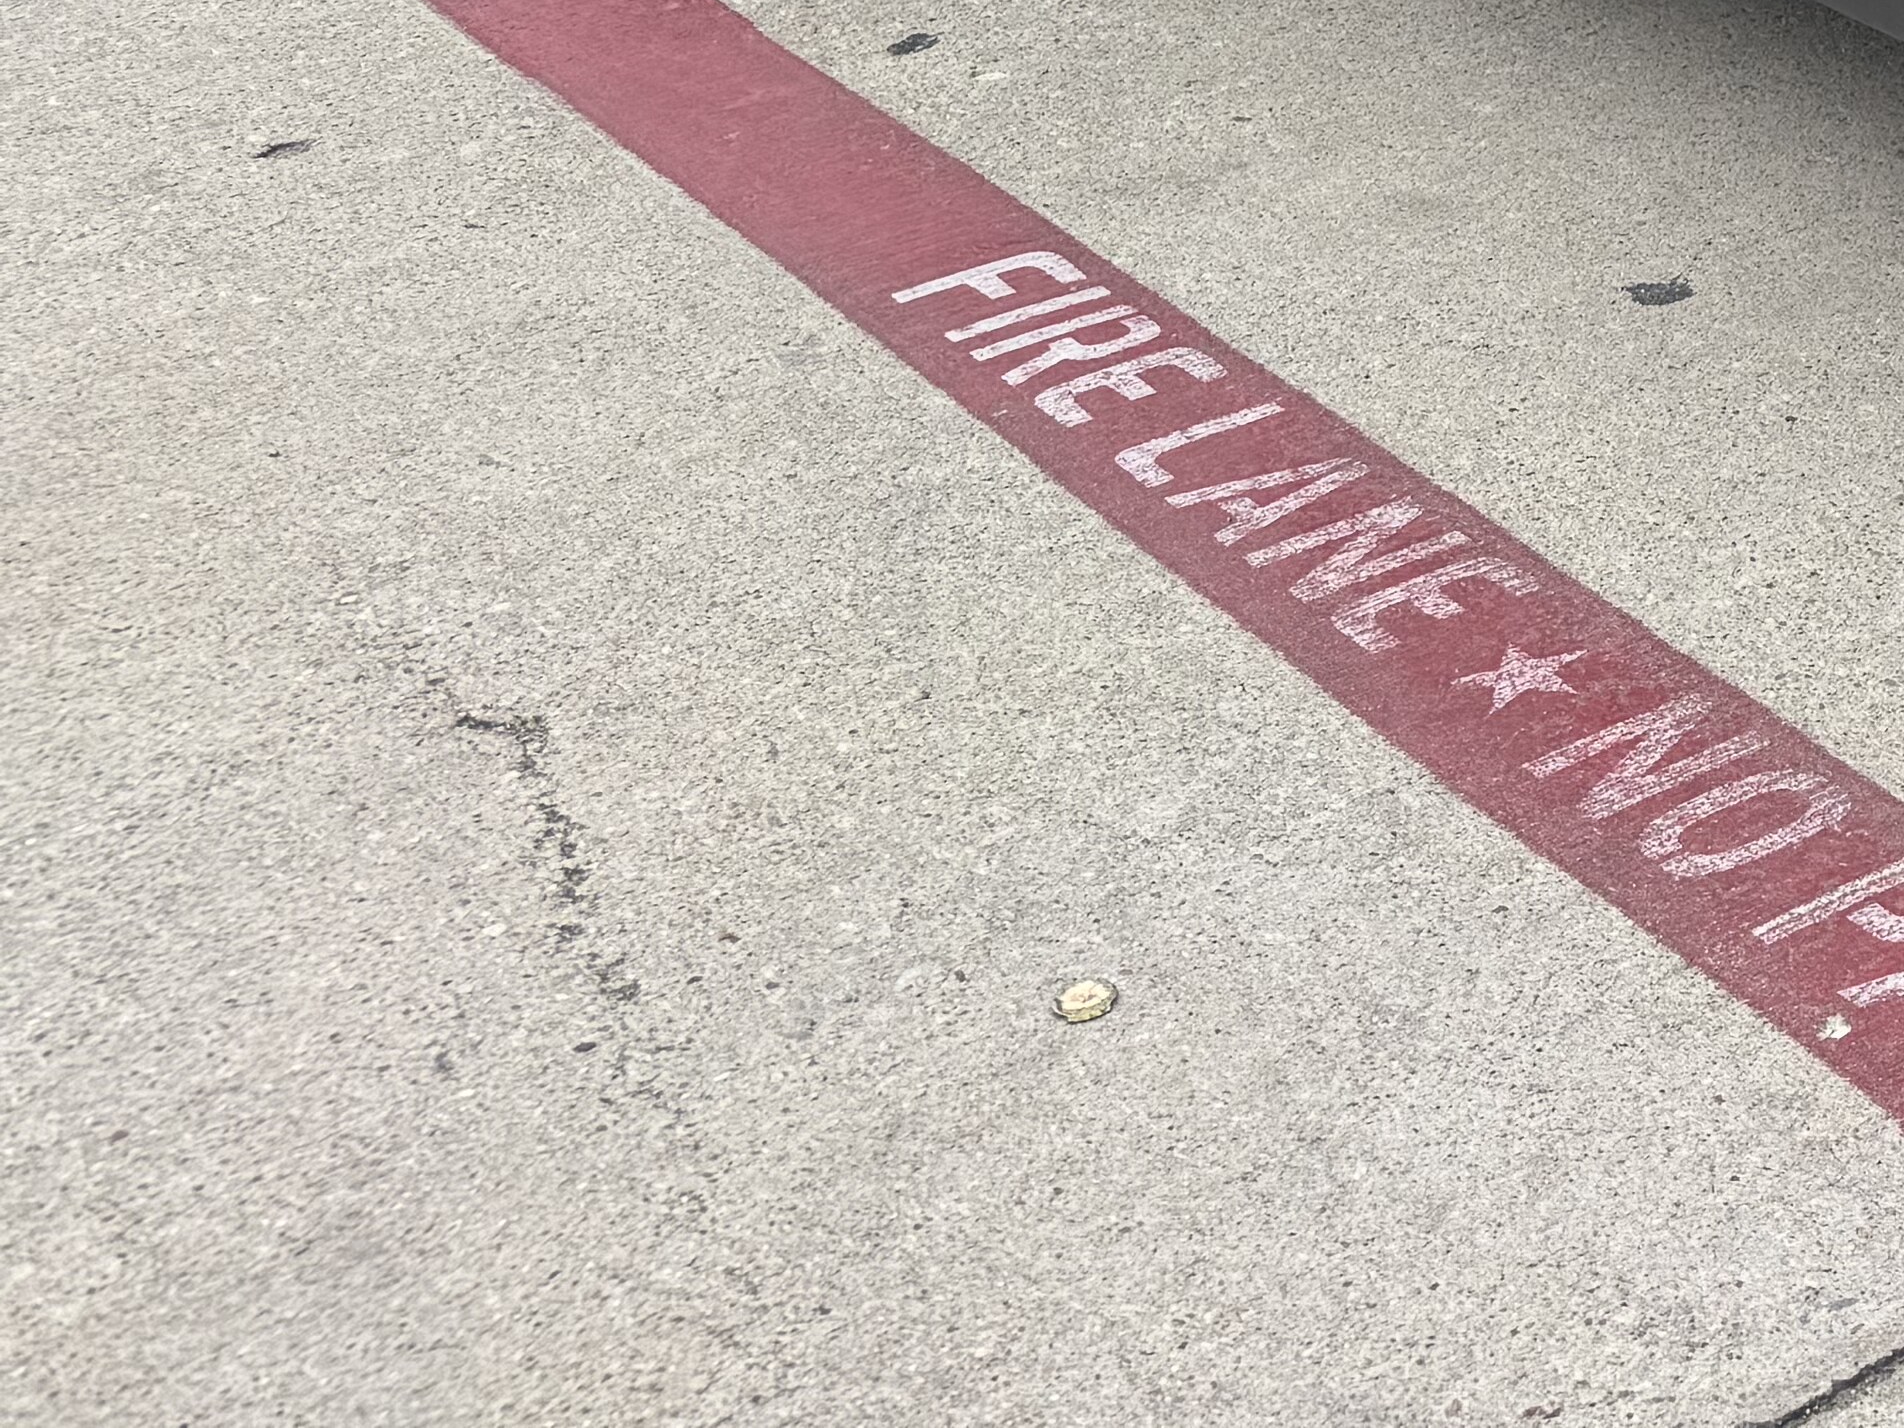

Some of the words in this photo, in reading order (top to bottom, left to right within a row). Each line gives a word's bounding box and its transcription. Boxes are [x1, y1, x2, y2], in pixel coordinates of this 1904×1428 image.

[891, 250, 1227, 428] FIRE
[1114, 398, 1541, 653] LANE
[1526, 692, 1855, 879] NO
